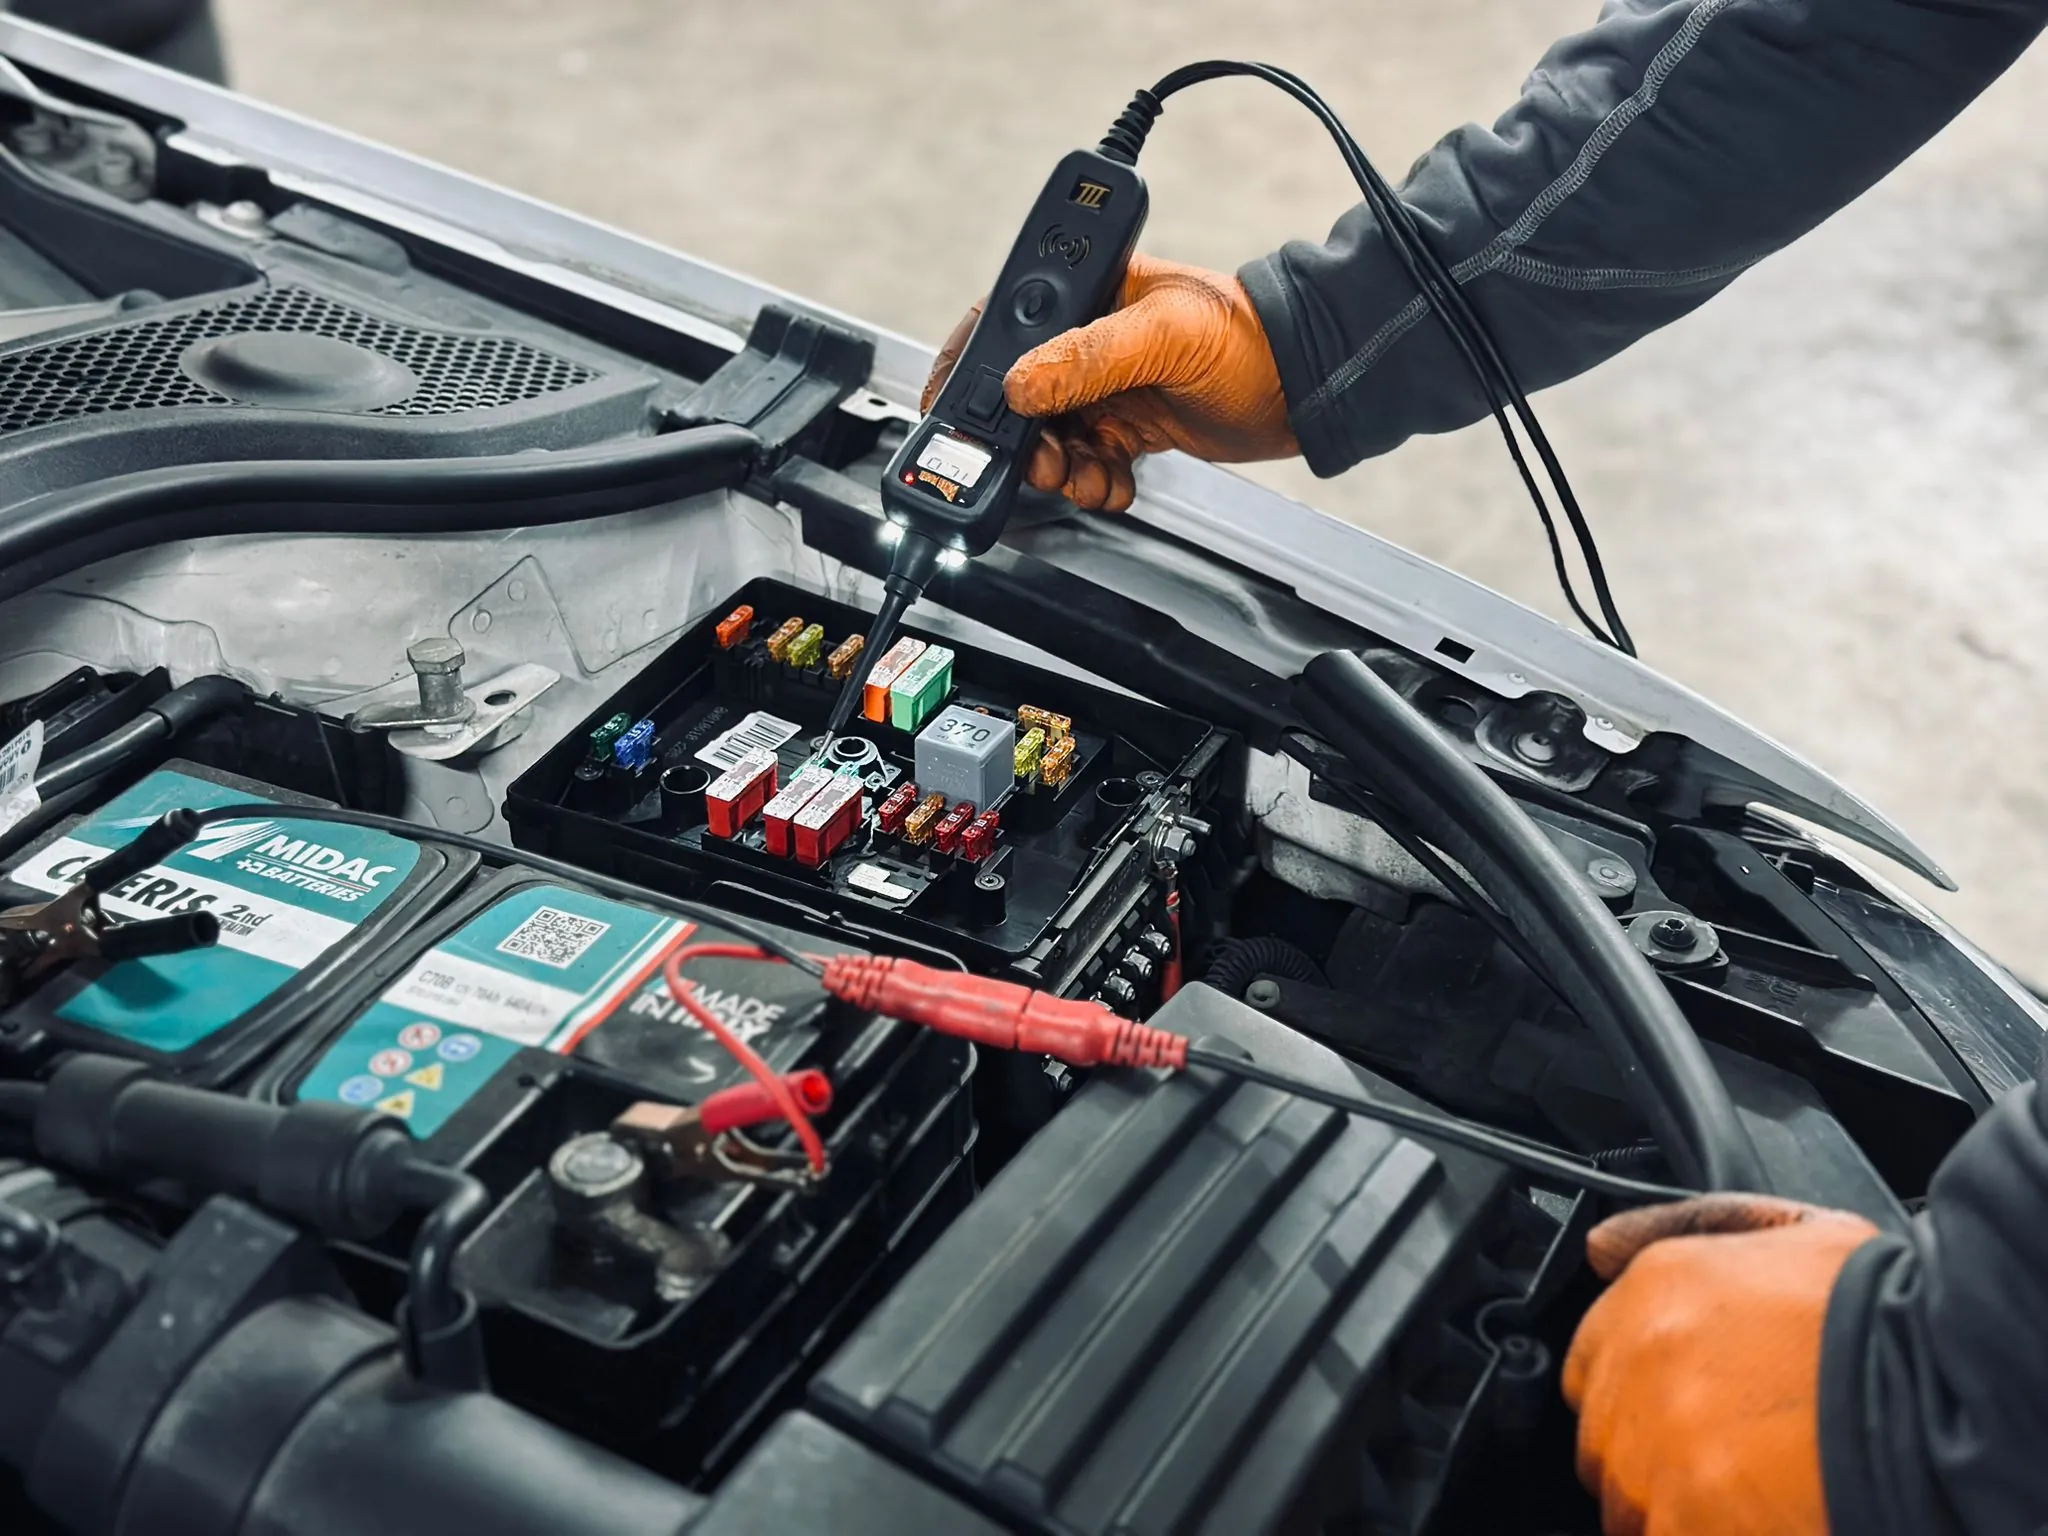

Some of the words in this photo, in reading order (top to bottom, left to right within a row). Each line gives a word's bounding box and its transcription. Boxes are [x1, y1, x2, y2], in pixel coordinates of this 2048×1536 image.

[939, 718, 991, 742] 370
[891, 793, 904, 803] 10
[947, 813, 961, 822] 10
[974, 819, 988, 828] 10
[253, 834, 397, 887] MIDAC
[259, 866, 365, 902] BATTERIES
[218, 903, 274, 926] 2nd
[628, 990, 676, 1021] IN
[693, 985, 787, 1021] MADE
